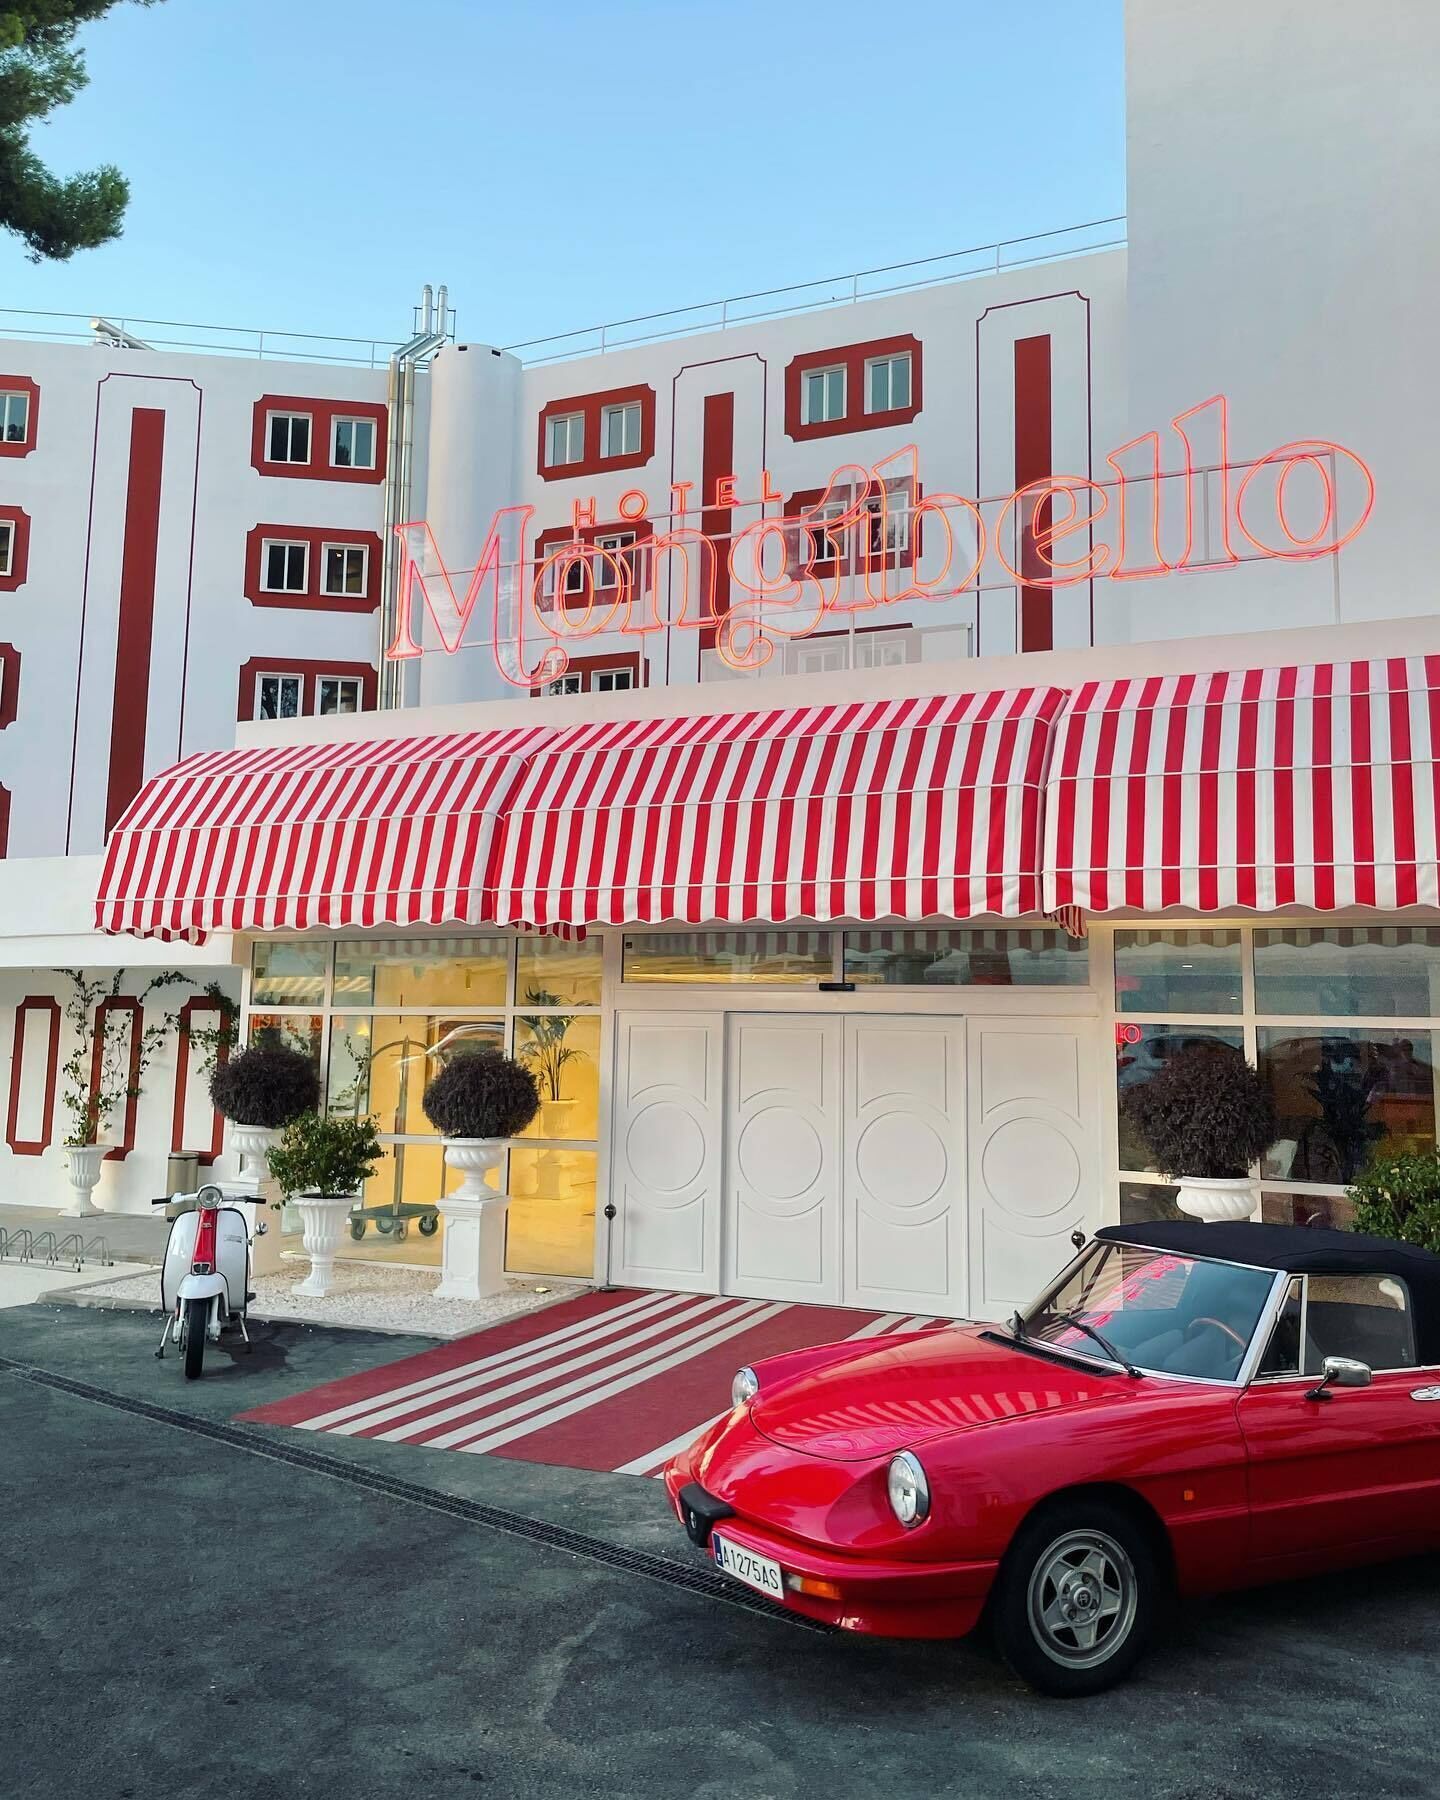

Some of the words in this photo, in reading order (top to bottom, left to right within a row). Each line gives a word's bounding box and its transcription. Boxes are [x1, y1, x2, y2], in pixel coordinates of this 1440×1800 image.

[573, 470, 783, 529] HOTEL
[385, 394, 1375, 689] Mongibello
[723, 1545, 779, 1590] A1275AS
